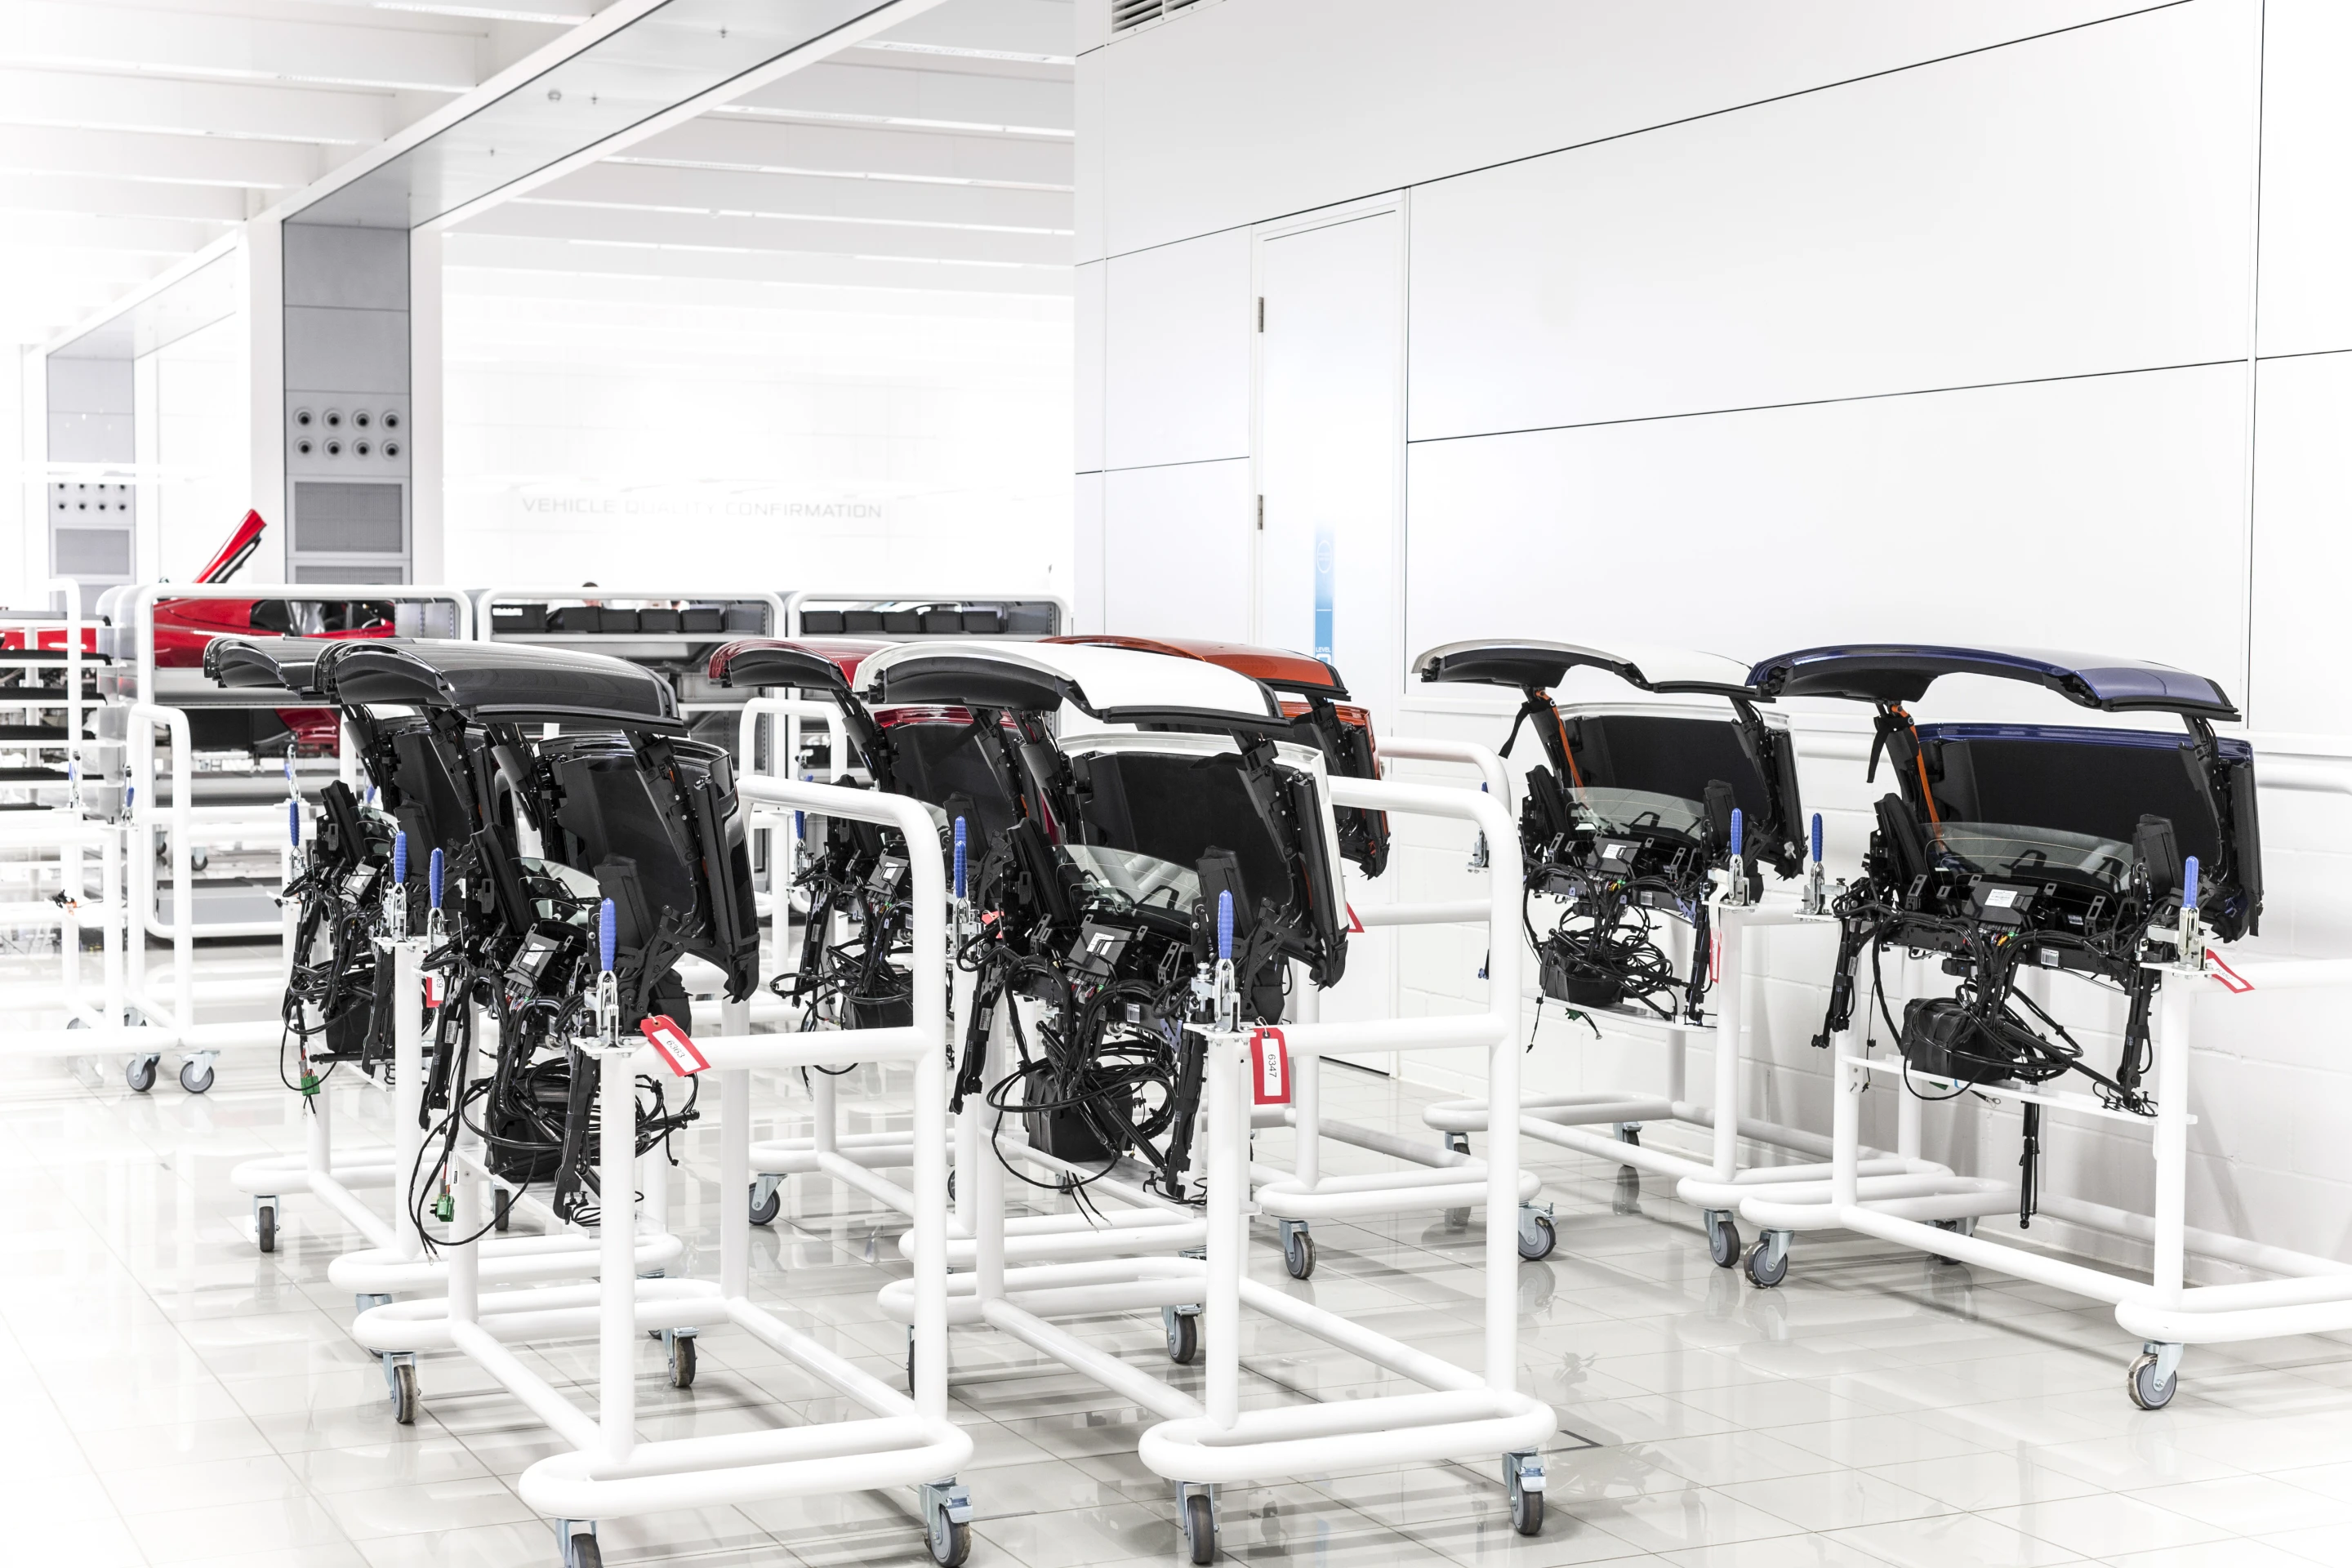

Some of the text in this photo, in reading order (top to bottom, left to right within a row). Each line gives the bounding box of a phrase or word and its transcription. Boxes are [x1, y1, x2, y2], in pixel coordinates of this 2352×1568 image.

[522, 497, 883, 519] VEHICLE QUALITY CONFIRMATION
[666, 1040, 685, 1058] 6363
[1267, 1054, 1277, 1078] 6347
